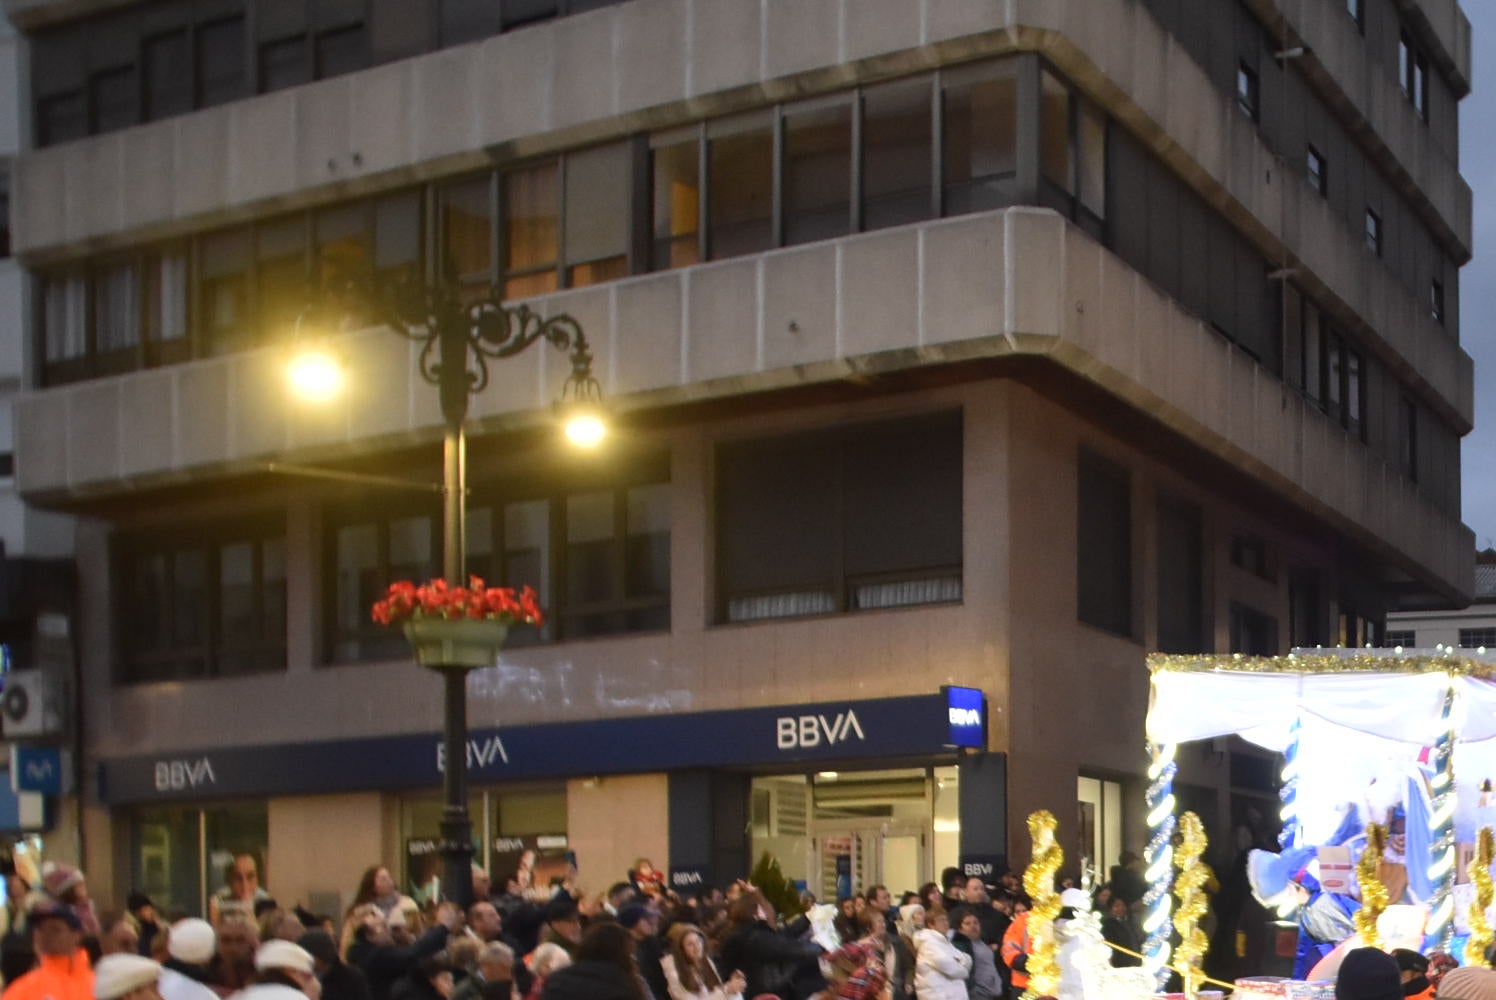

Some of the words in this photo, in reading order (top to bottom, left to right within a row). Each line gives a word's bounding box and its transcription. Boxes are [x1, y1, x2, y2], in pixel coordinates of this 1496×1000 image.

[776, 709, 865, 749] BBVA
[948, 707, 981, 727] BBVA
[155, 757, 215, 791] BBVA
[672, 871, 702, 885] BBVA
